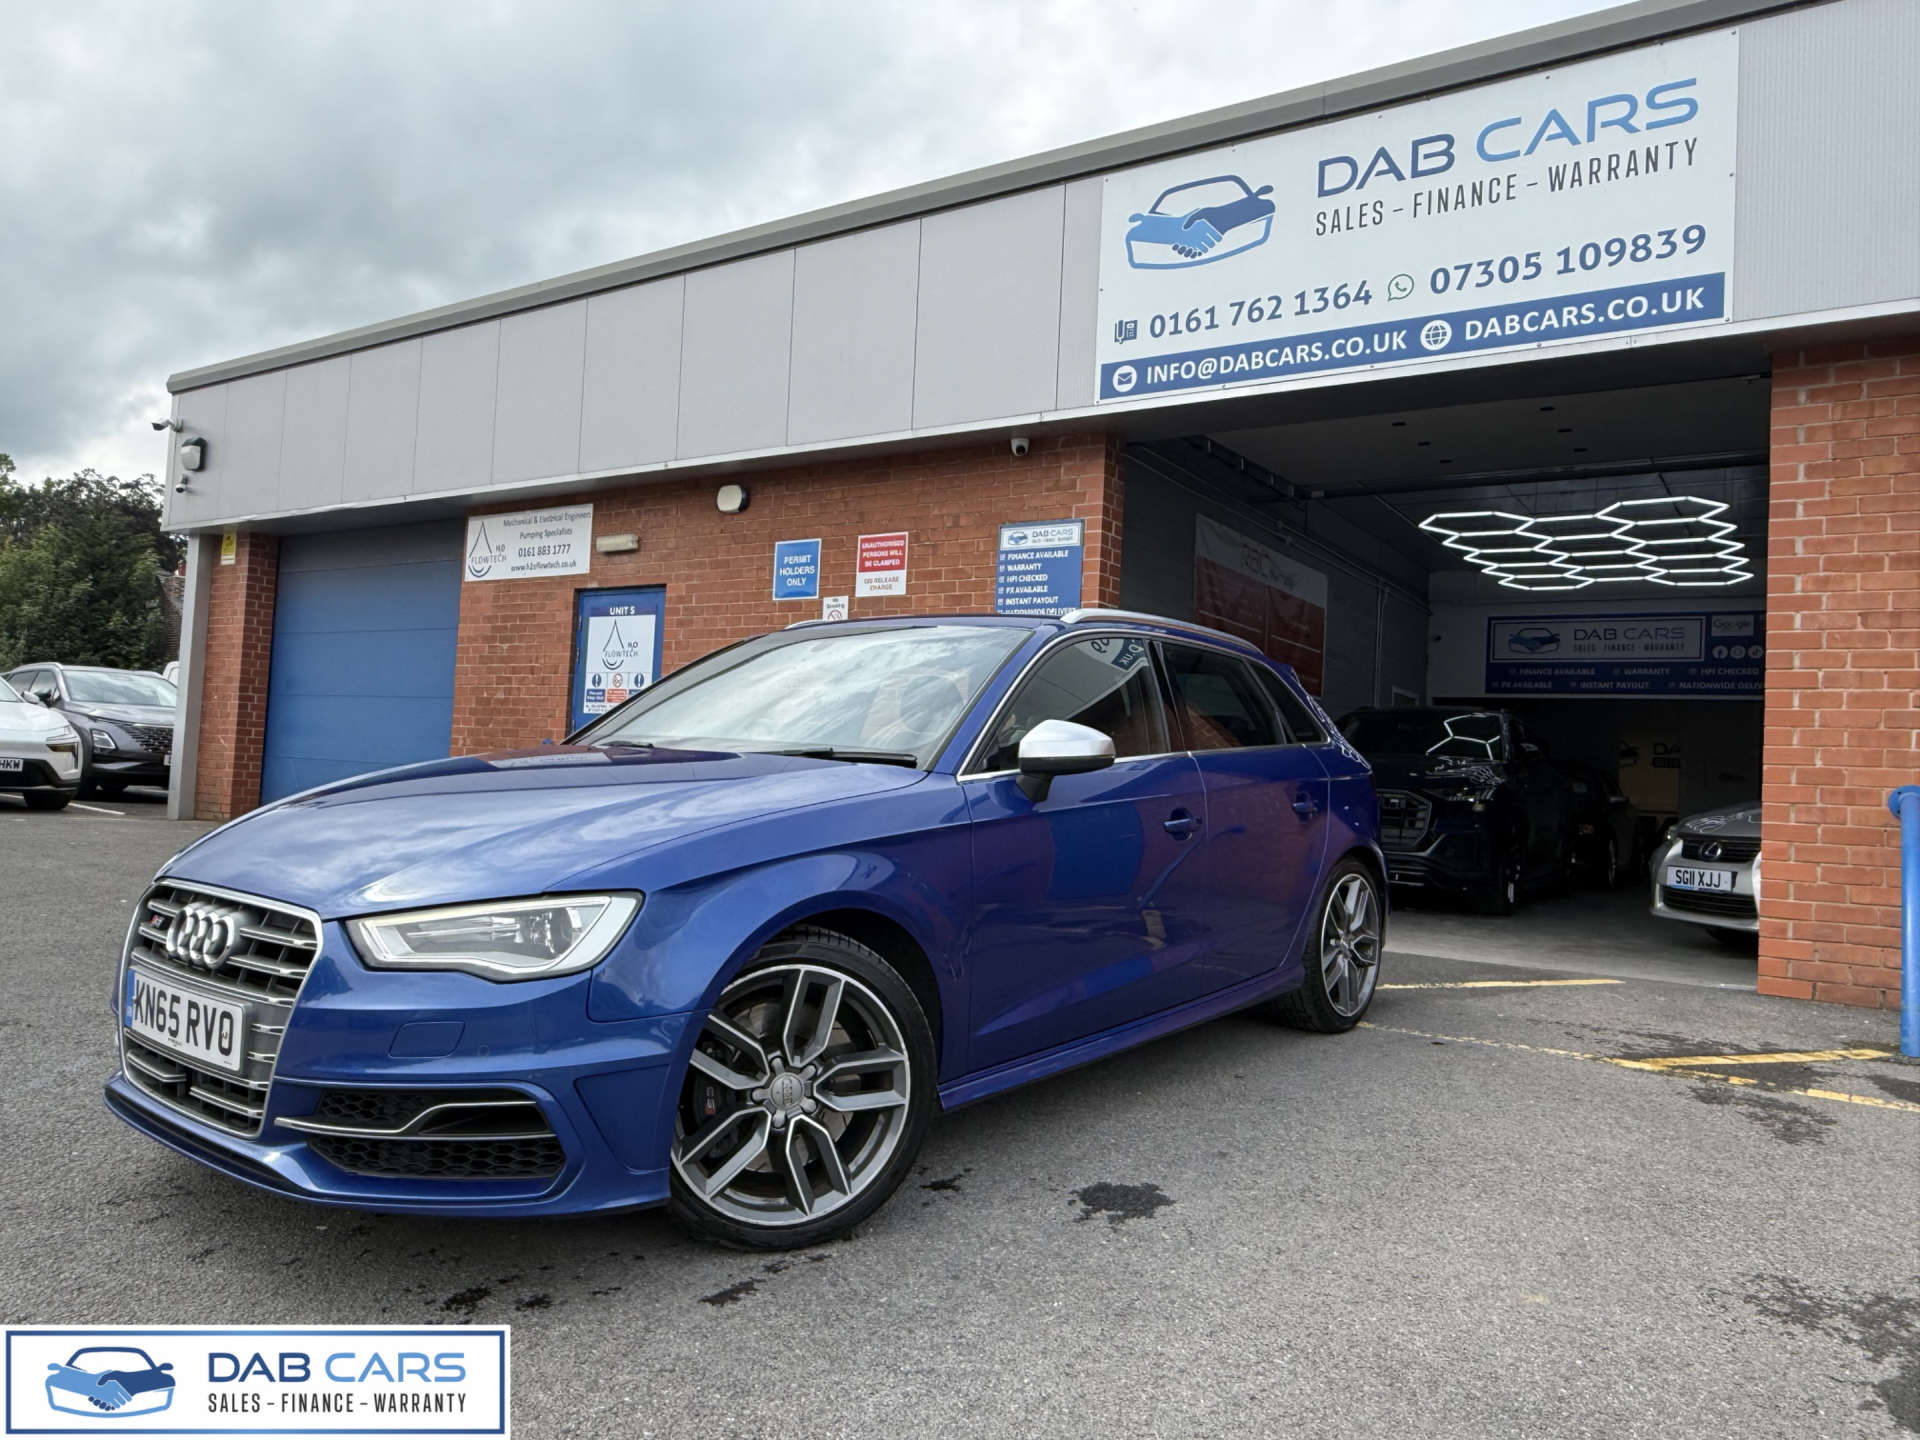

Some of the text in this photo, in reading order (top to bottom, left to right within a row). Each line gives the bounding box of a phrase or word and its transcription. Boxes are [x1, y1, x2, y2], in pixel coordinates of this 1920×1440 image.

[1317, 78, 1698, 198] DAB CARS
[1316, 200, 1384, 236] SALES
[1413, 173, 1518, 218] FINANCE
[1548, 137, 1698, 192] WARRANTY
[1430, 224, 1706, 294] 07305 109839
[1149, 280, 1372, 338] 0161 762 1364
[1465, 287, 1705, 341] DABCARS.CO.UK
[1147, 330, 1407, 384] INFO@DABCARS.CO.UK
[564, 511, 591, 521] Engineers
[520, 527, 573, 540] Pumping Specialists
[1050, 528, 1073, 536] CARS
[518, 547, 535, 558] 0161
[552, 544, 571, 555] 1777
[1007, 550, 1069, 560] FINANCE AVAILABLE
[471, 554, 507, 565] FLOWTECH
[784, 555, 811, 564] PERMIT
[873, 559, 900, 567] CLAMPED
[779, 565, 815, 576] HOLDERS
[1007, 563, 1042, 572] WARRANTY
[786, 577, 807, 586] ONLY
[1019, 574, 1048, 582] CHECKED
[1016, 585, 1048, 593] AVAILABLE
[1006, 596, 1059, 605] INSTANT PAYOUT
[609, 606, 636, 615] UNIT 5
[1573, 627, 1686, 641] DAB CARS
[605, 650, 638, 658] FLOWTECH
[1623, 667, 1670, 676] WARRANTY
[1580, 681, 1649, 689] INSTANT PAYOUT
[1675, 869, 1721, 888] SG11 XJJ
[134, 979, 234, 1057] KN65 RVO
